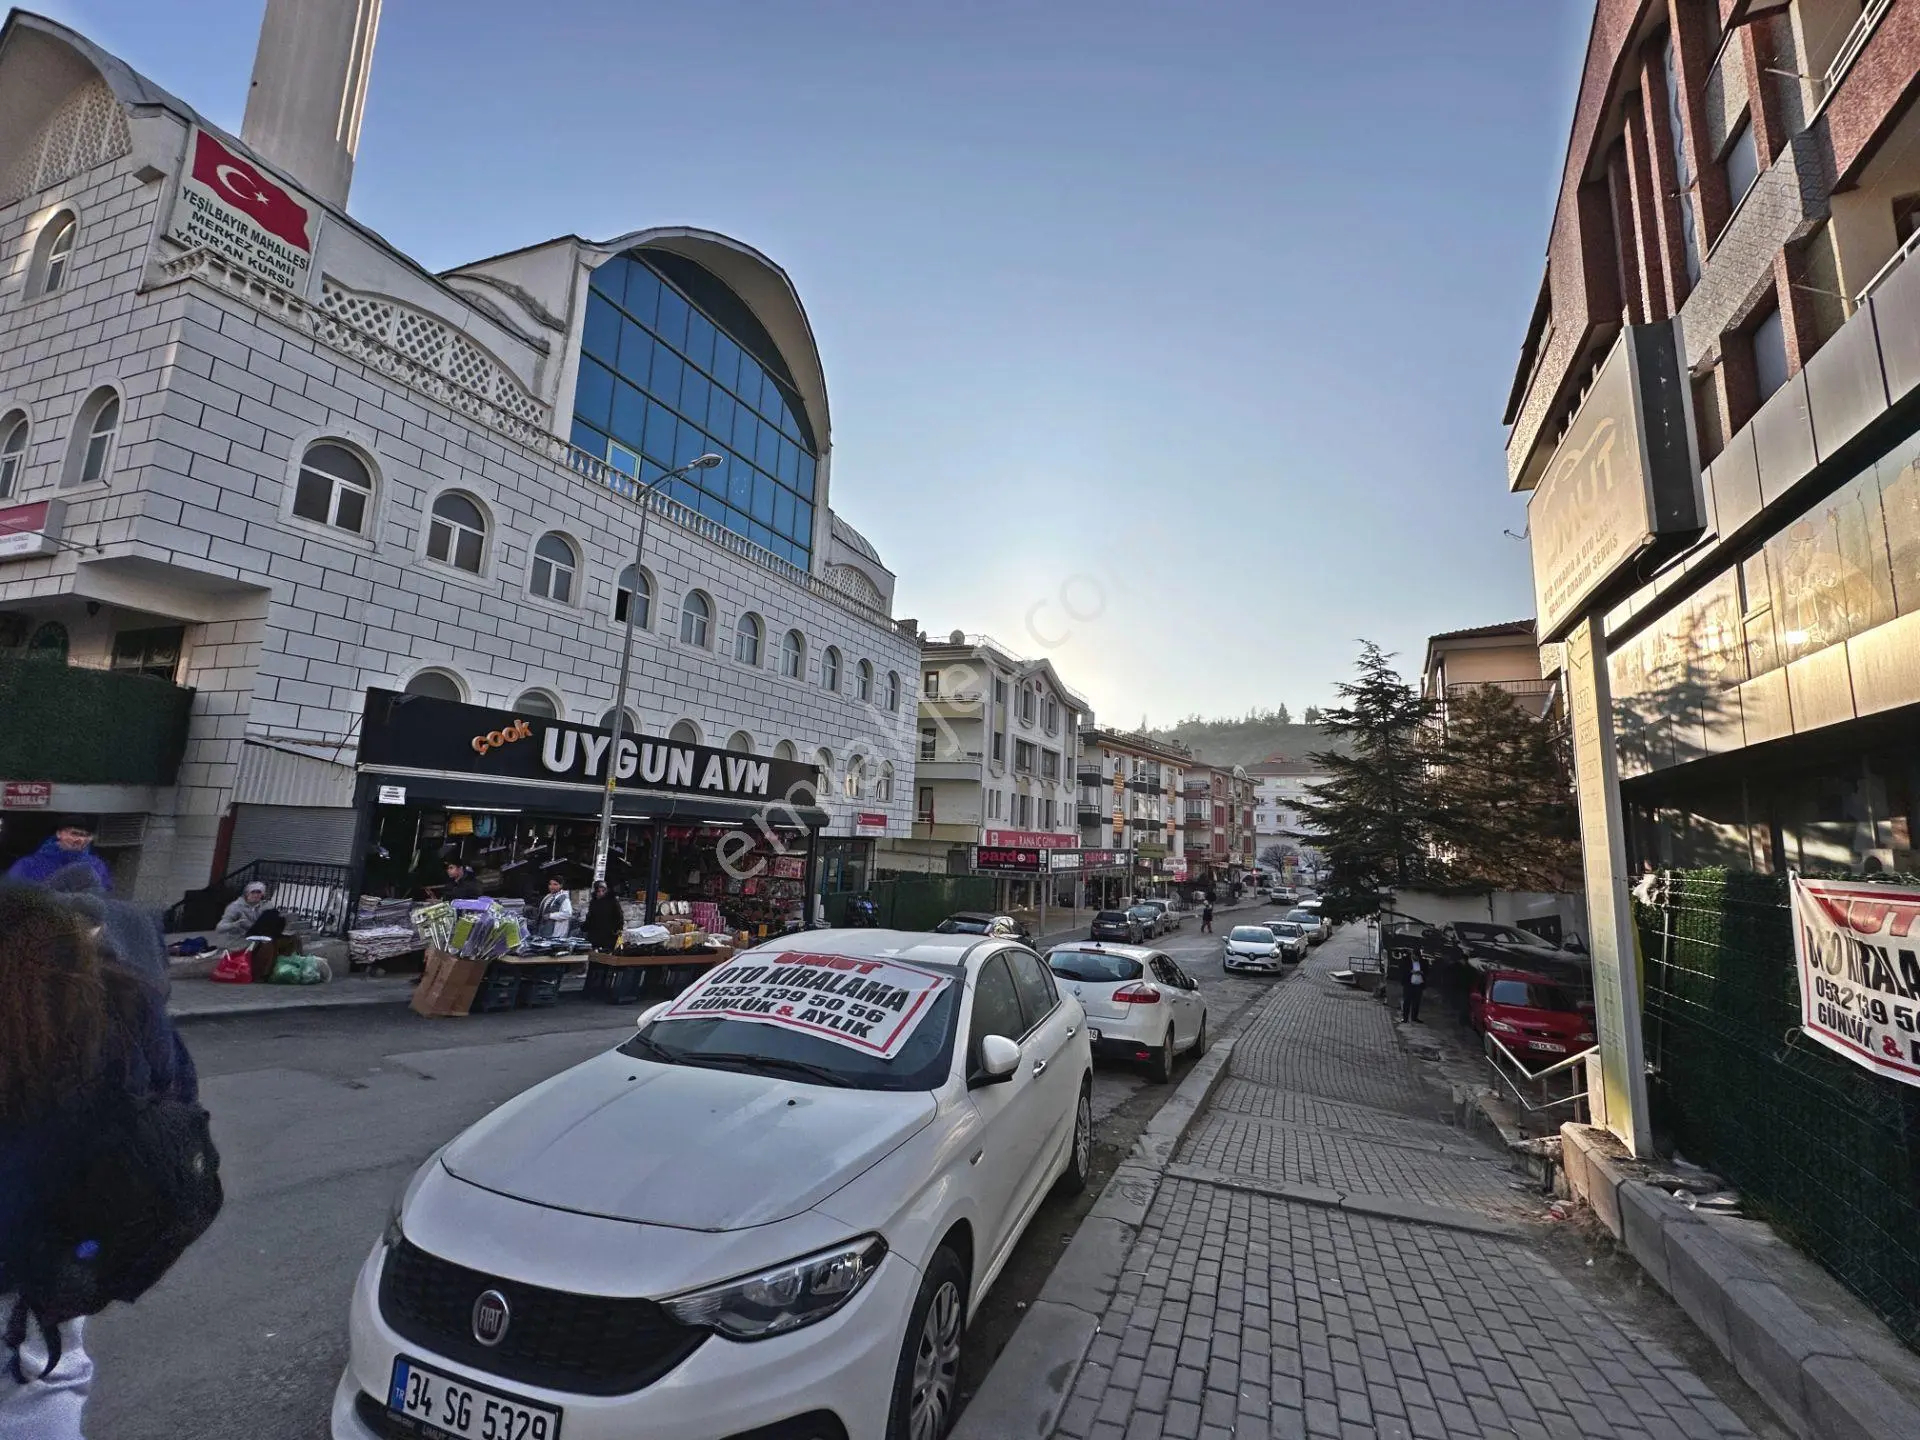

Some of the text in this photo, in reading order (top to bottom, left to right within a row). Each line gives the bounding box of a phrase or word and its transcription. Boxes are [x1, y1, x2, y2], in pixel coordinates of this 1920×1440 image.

[183, 186, 310, 272] YEŞİLBAYIR MAHALLESİ
[192, 211, 295, 277] MERKEZ CAMİİ
[187, 222, 294, 289] KUR'AN KURSU
[542, 727, 695, 786] UYGUN
[700, 754, 770, 795] AVM
[774, 952, 883, 975] UMUT
[702, 986, 886, 1023] 0532 139 50 56
[711, 966, 910, 1012] OTO KİRALAMA
[1856, 993, 1889, 1025] 139
[687, 996, 875, 1038] GÜNLÜK & AYLIK
[1882, 1034, 1905, 1060] &
[479, 1305, 502, 1332] FIAT
[395, 1387, 404, 1398] TR
[406, 1372, 547, 1440] 34 SG 5329
